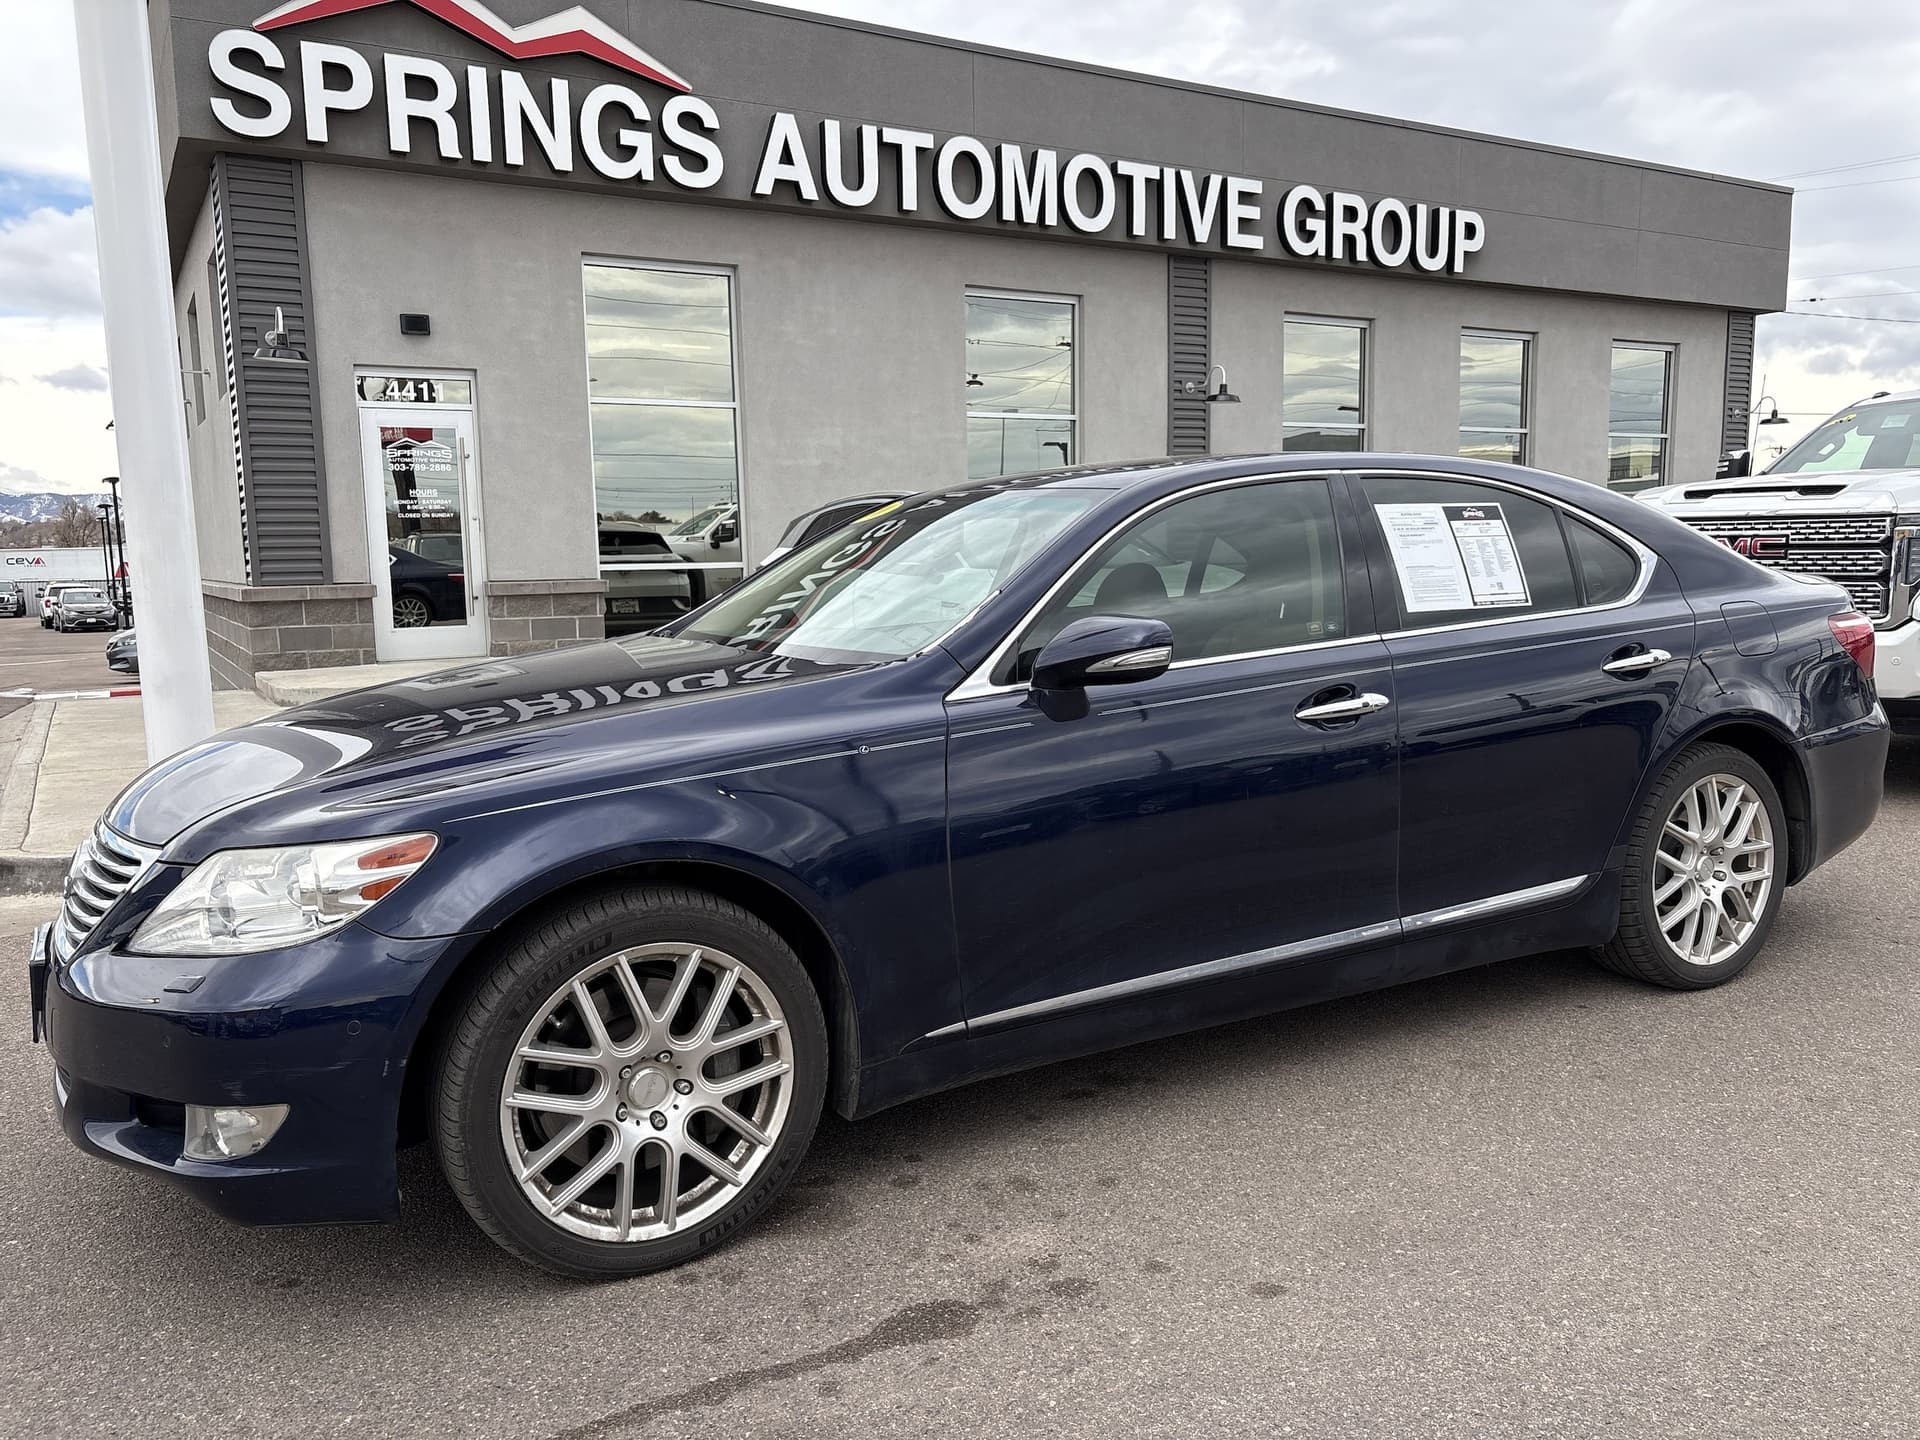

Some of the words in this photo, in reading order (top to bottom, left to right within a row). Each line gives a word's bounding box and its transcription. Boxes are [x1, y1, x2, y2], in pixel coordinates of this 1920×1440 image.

[207, 28, 725, 190] SPRINGS
[751, 111, 1264, 251] AUTOMOTIVE
[1279, 184, 1486, 274] GROUP
[386, 380, 443, 401] 4411
[386, 448, 453, 459] SPRINGS
[409, 489, 438, 497] HOURS
[1716, 537, 1787, 557] MC
